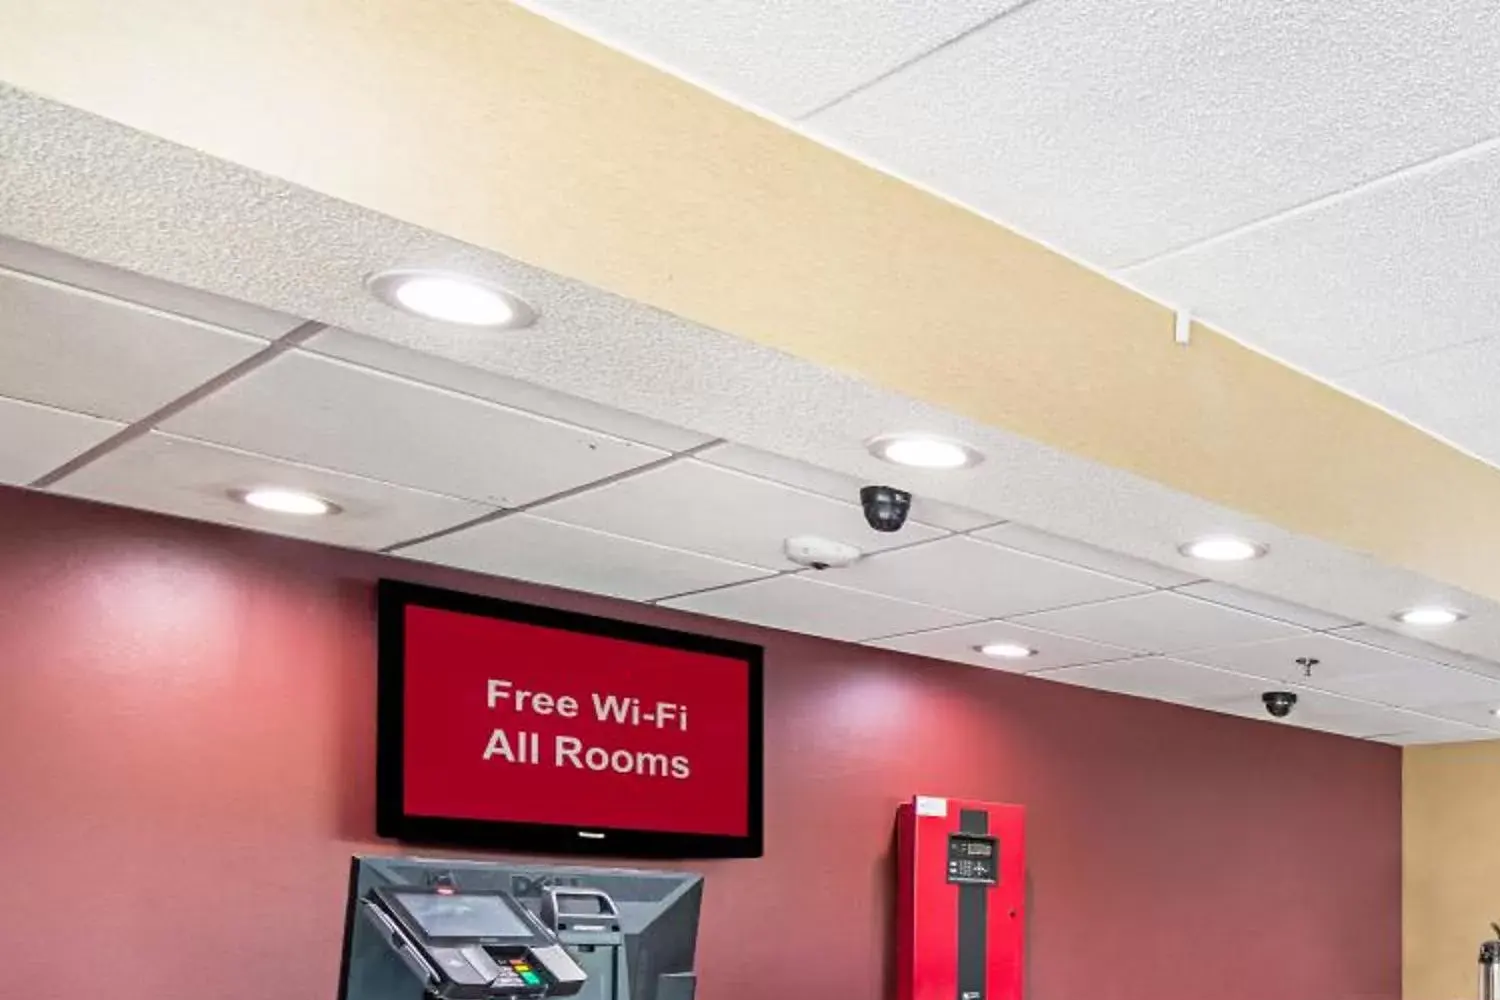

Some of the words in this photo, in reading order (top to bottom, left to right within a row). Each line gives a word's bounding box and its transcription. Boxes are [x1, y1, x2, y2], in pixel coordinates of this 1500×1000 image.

[487, 679, 579, 718] Free
[591, 692, 688, 731] Wi-Fi
[482, 728, 539, 765] All
[555, 735, 691, 780] Rooms
